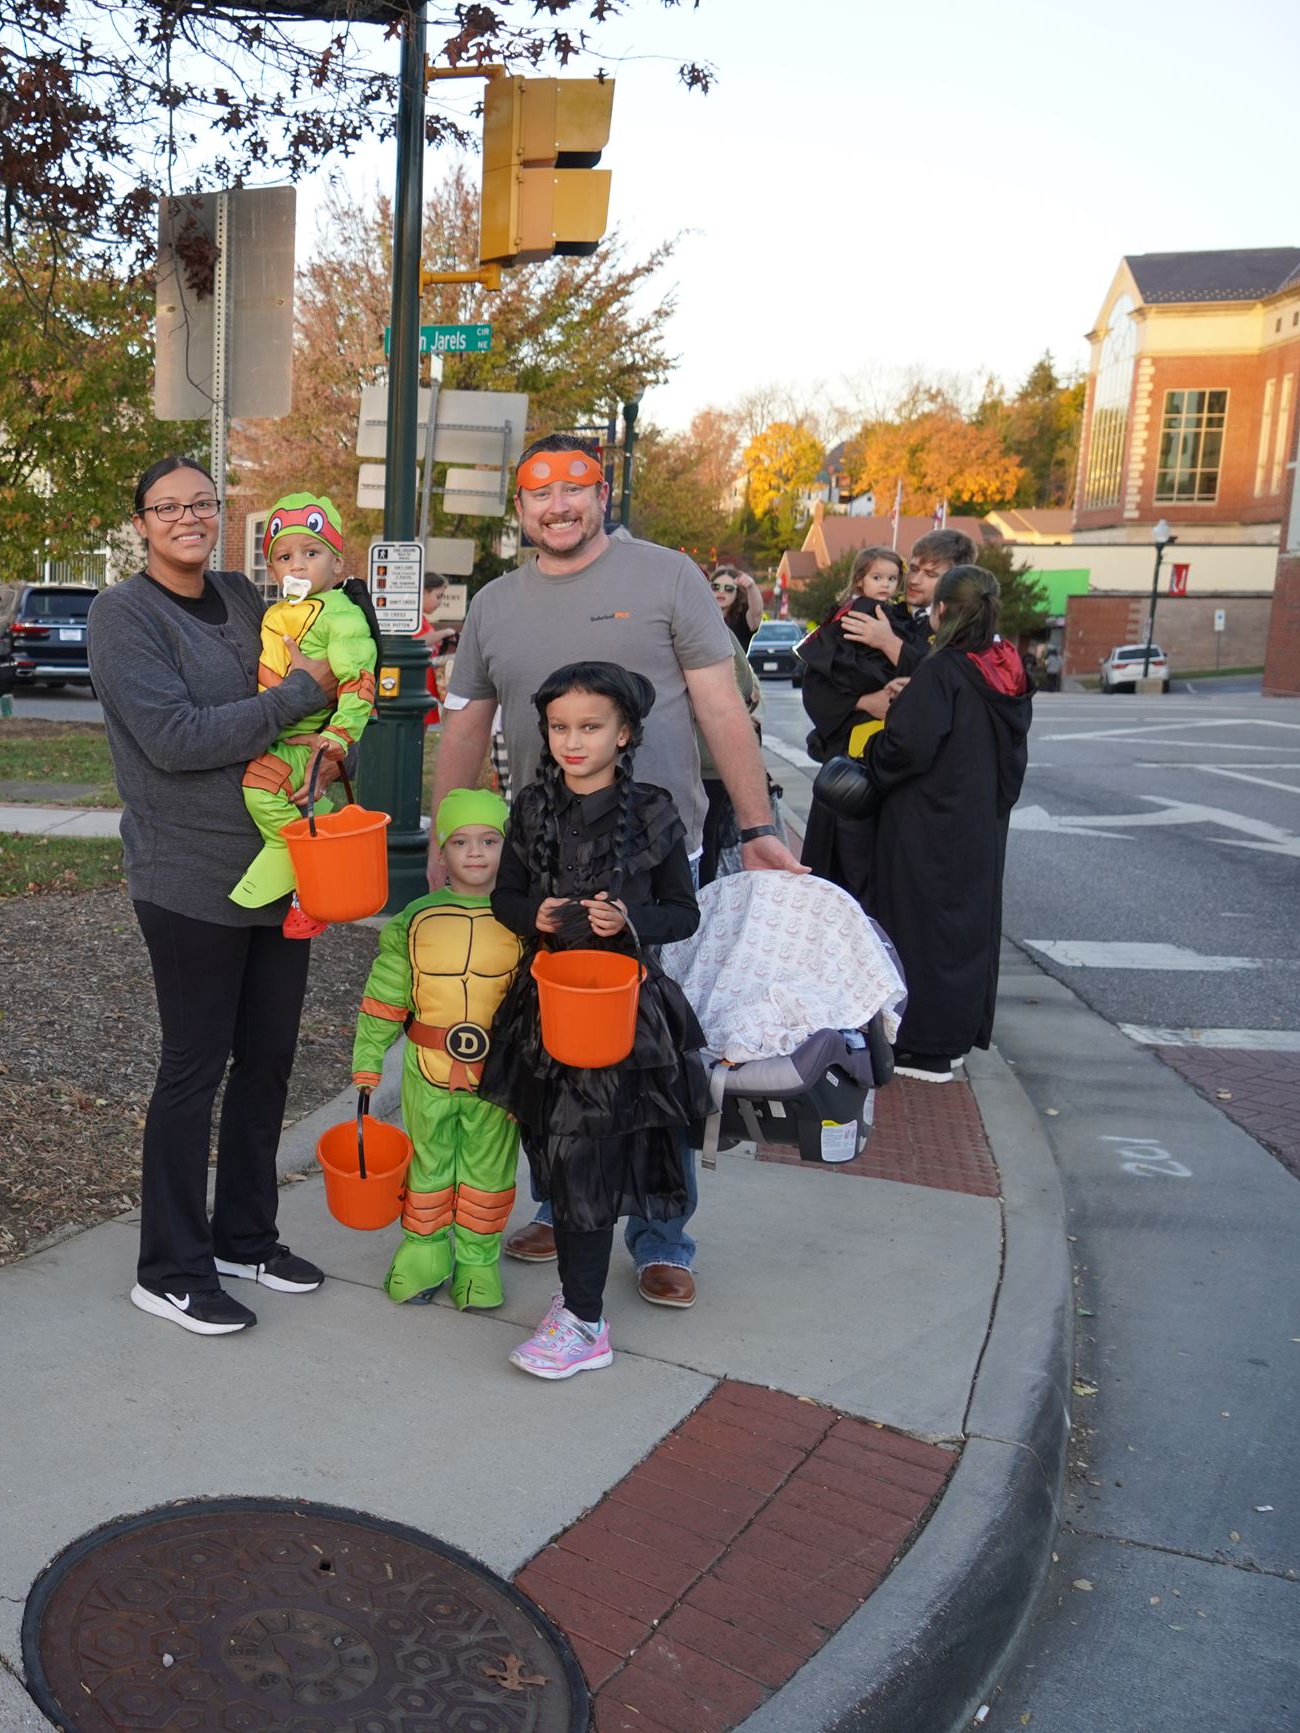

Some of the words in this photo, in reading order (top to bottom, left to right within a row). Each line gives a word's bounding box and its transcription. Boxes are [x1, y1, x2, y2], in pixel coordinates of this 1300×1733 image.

[476, 328, 489, 336] CIR
[430, 331, 466, 350] Jarels
[477, 341, 488, 349] NE
[457, 1031, 479, 1054] D
